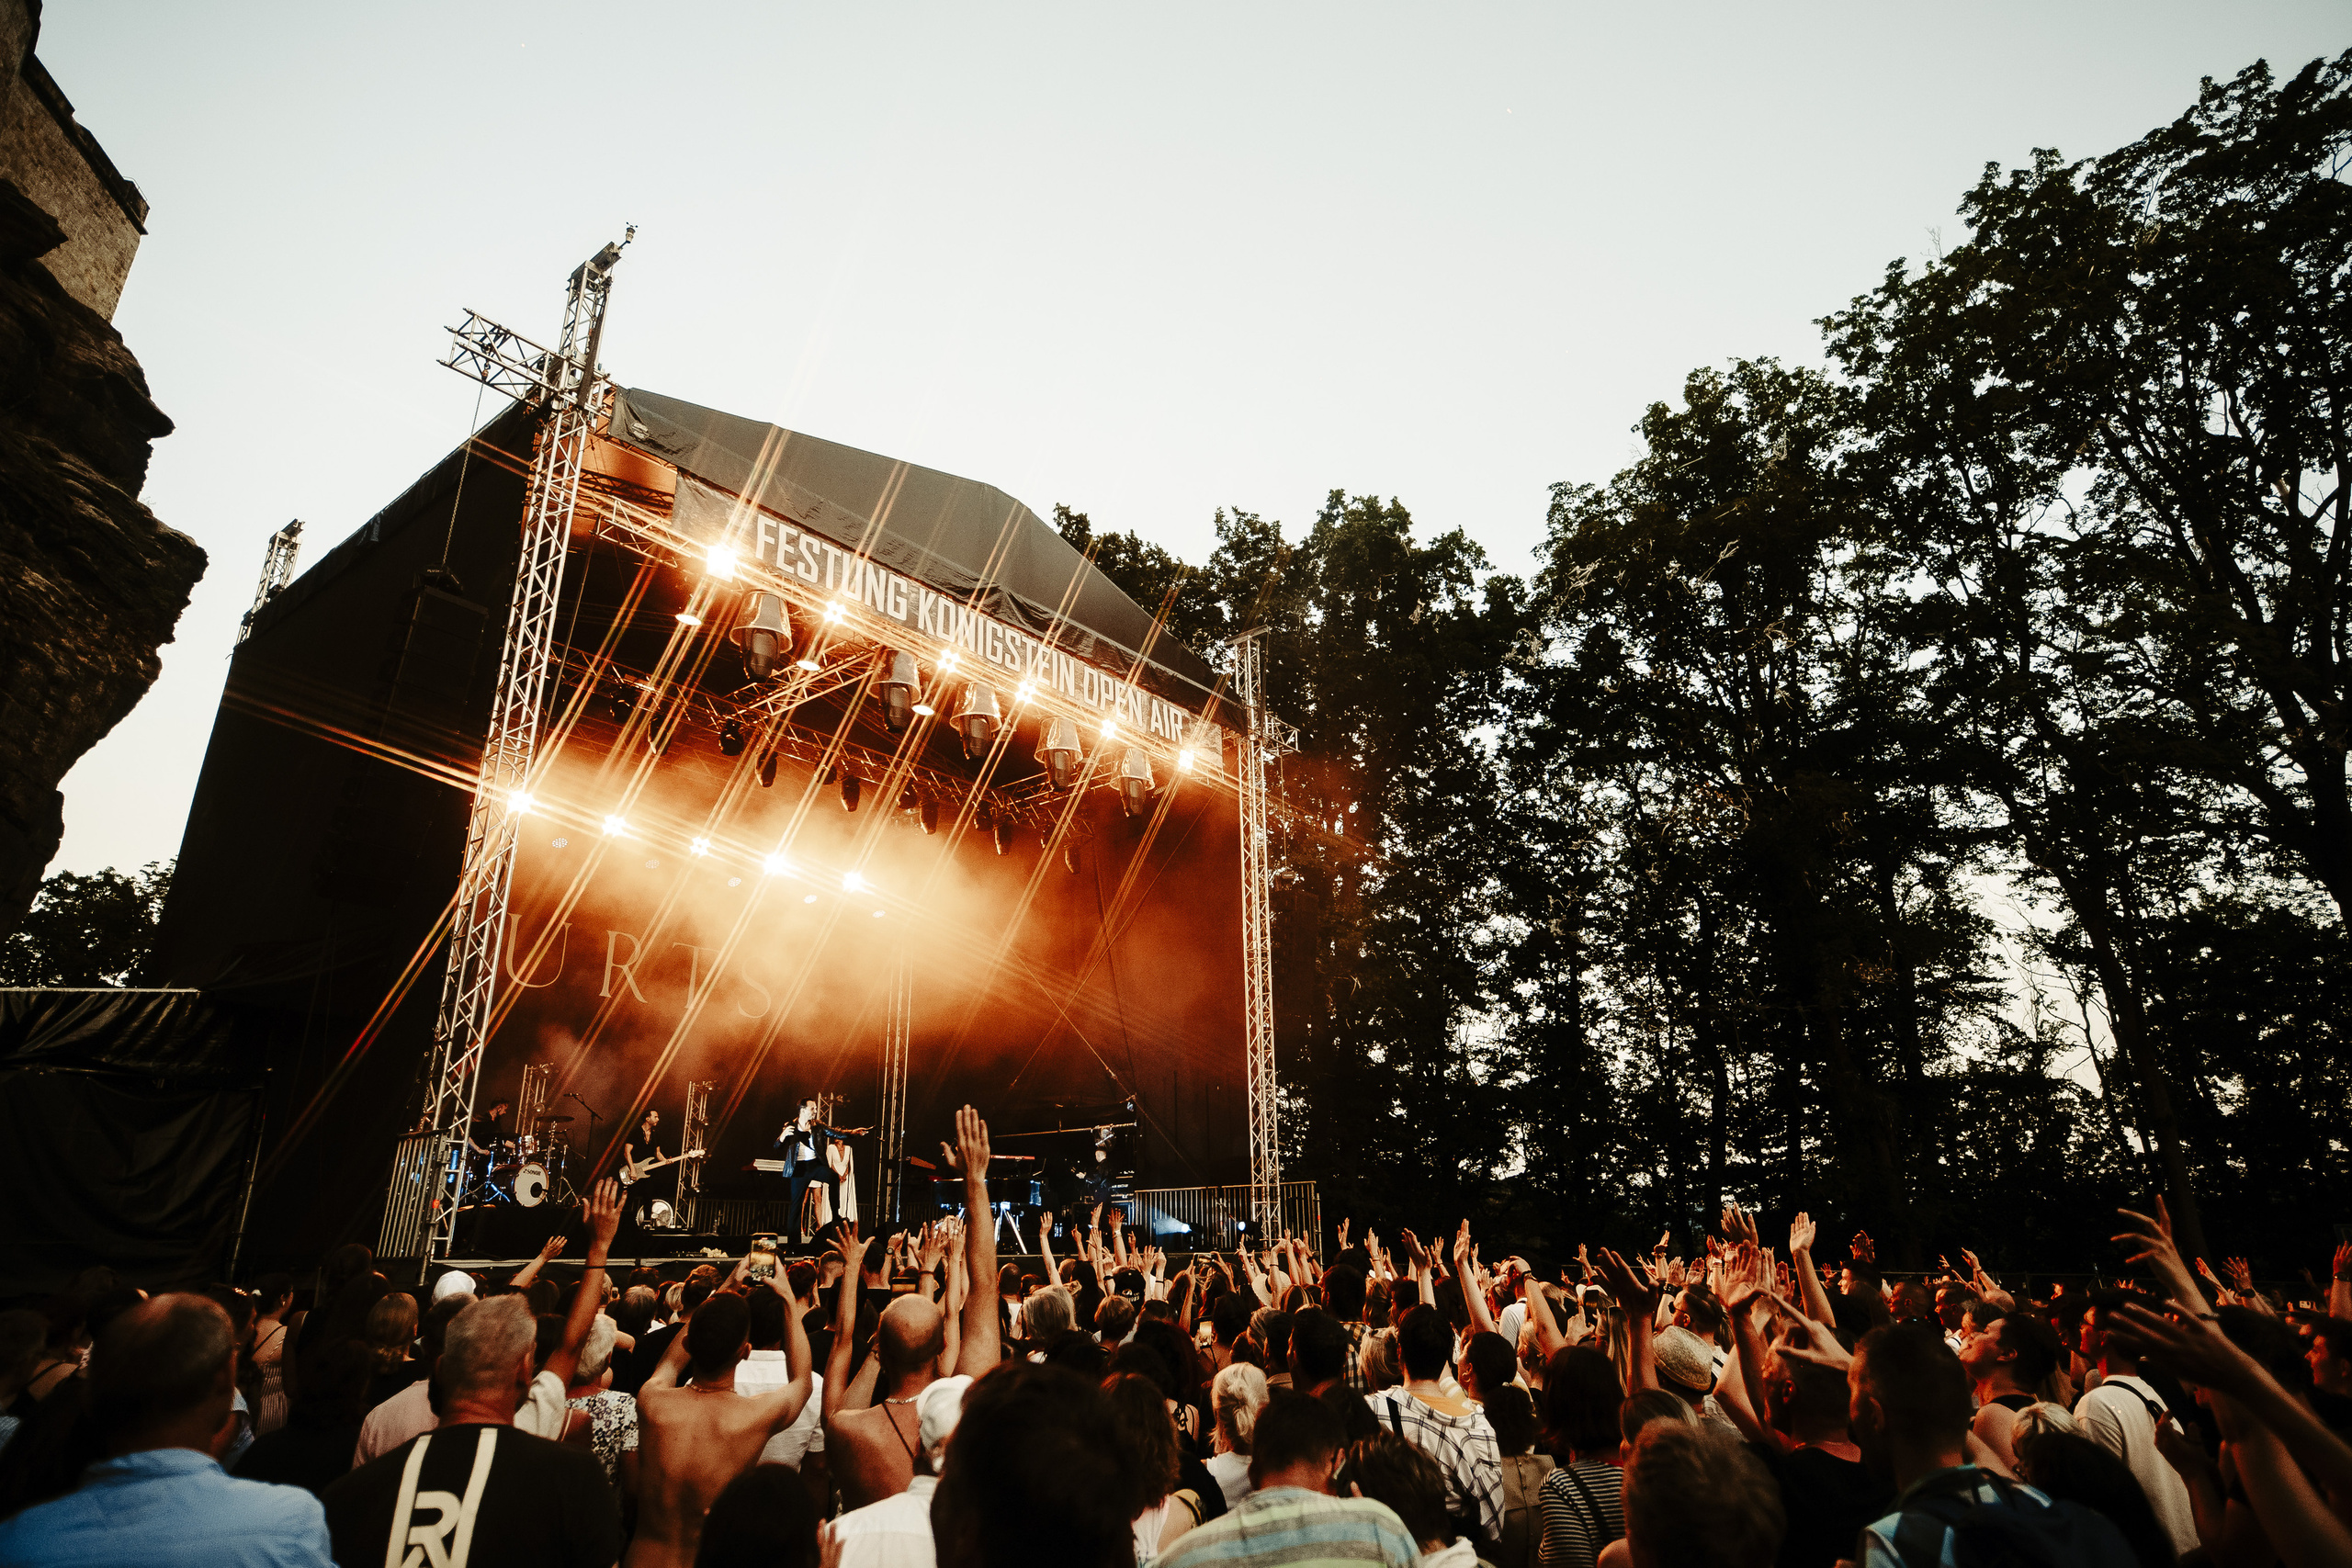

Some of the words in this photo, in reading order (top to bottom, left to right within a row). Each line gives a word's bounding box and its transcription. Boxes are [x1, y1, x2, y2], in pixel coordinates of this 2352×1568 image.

[755, 513, 908, 621] FESTUNG
[1084, 665, 1143, 728] OPEN
[1150, 699, 1183, 746] AIR
[459, 908, 772, 1019] URTS
